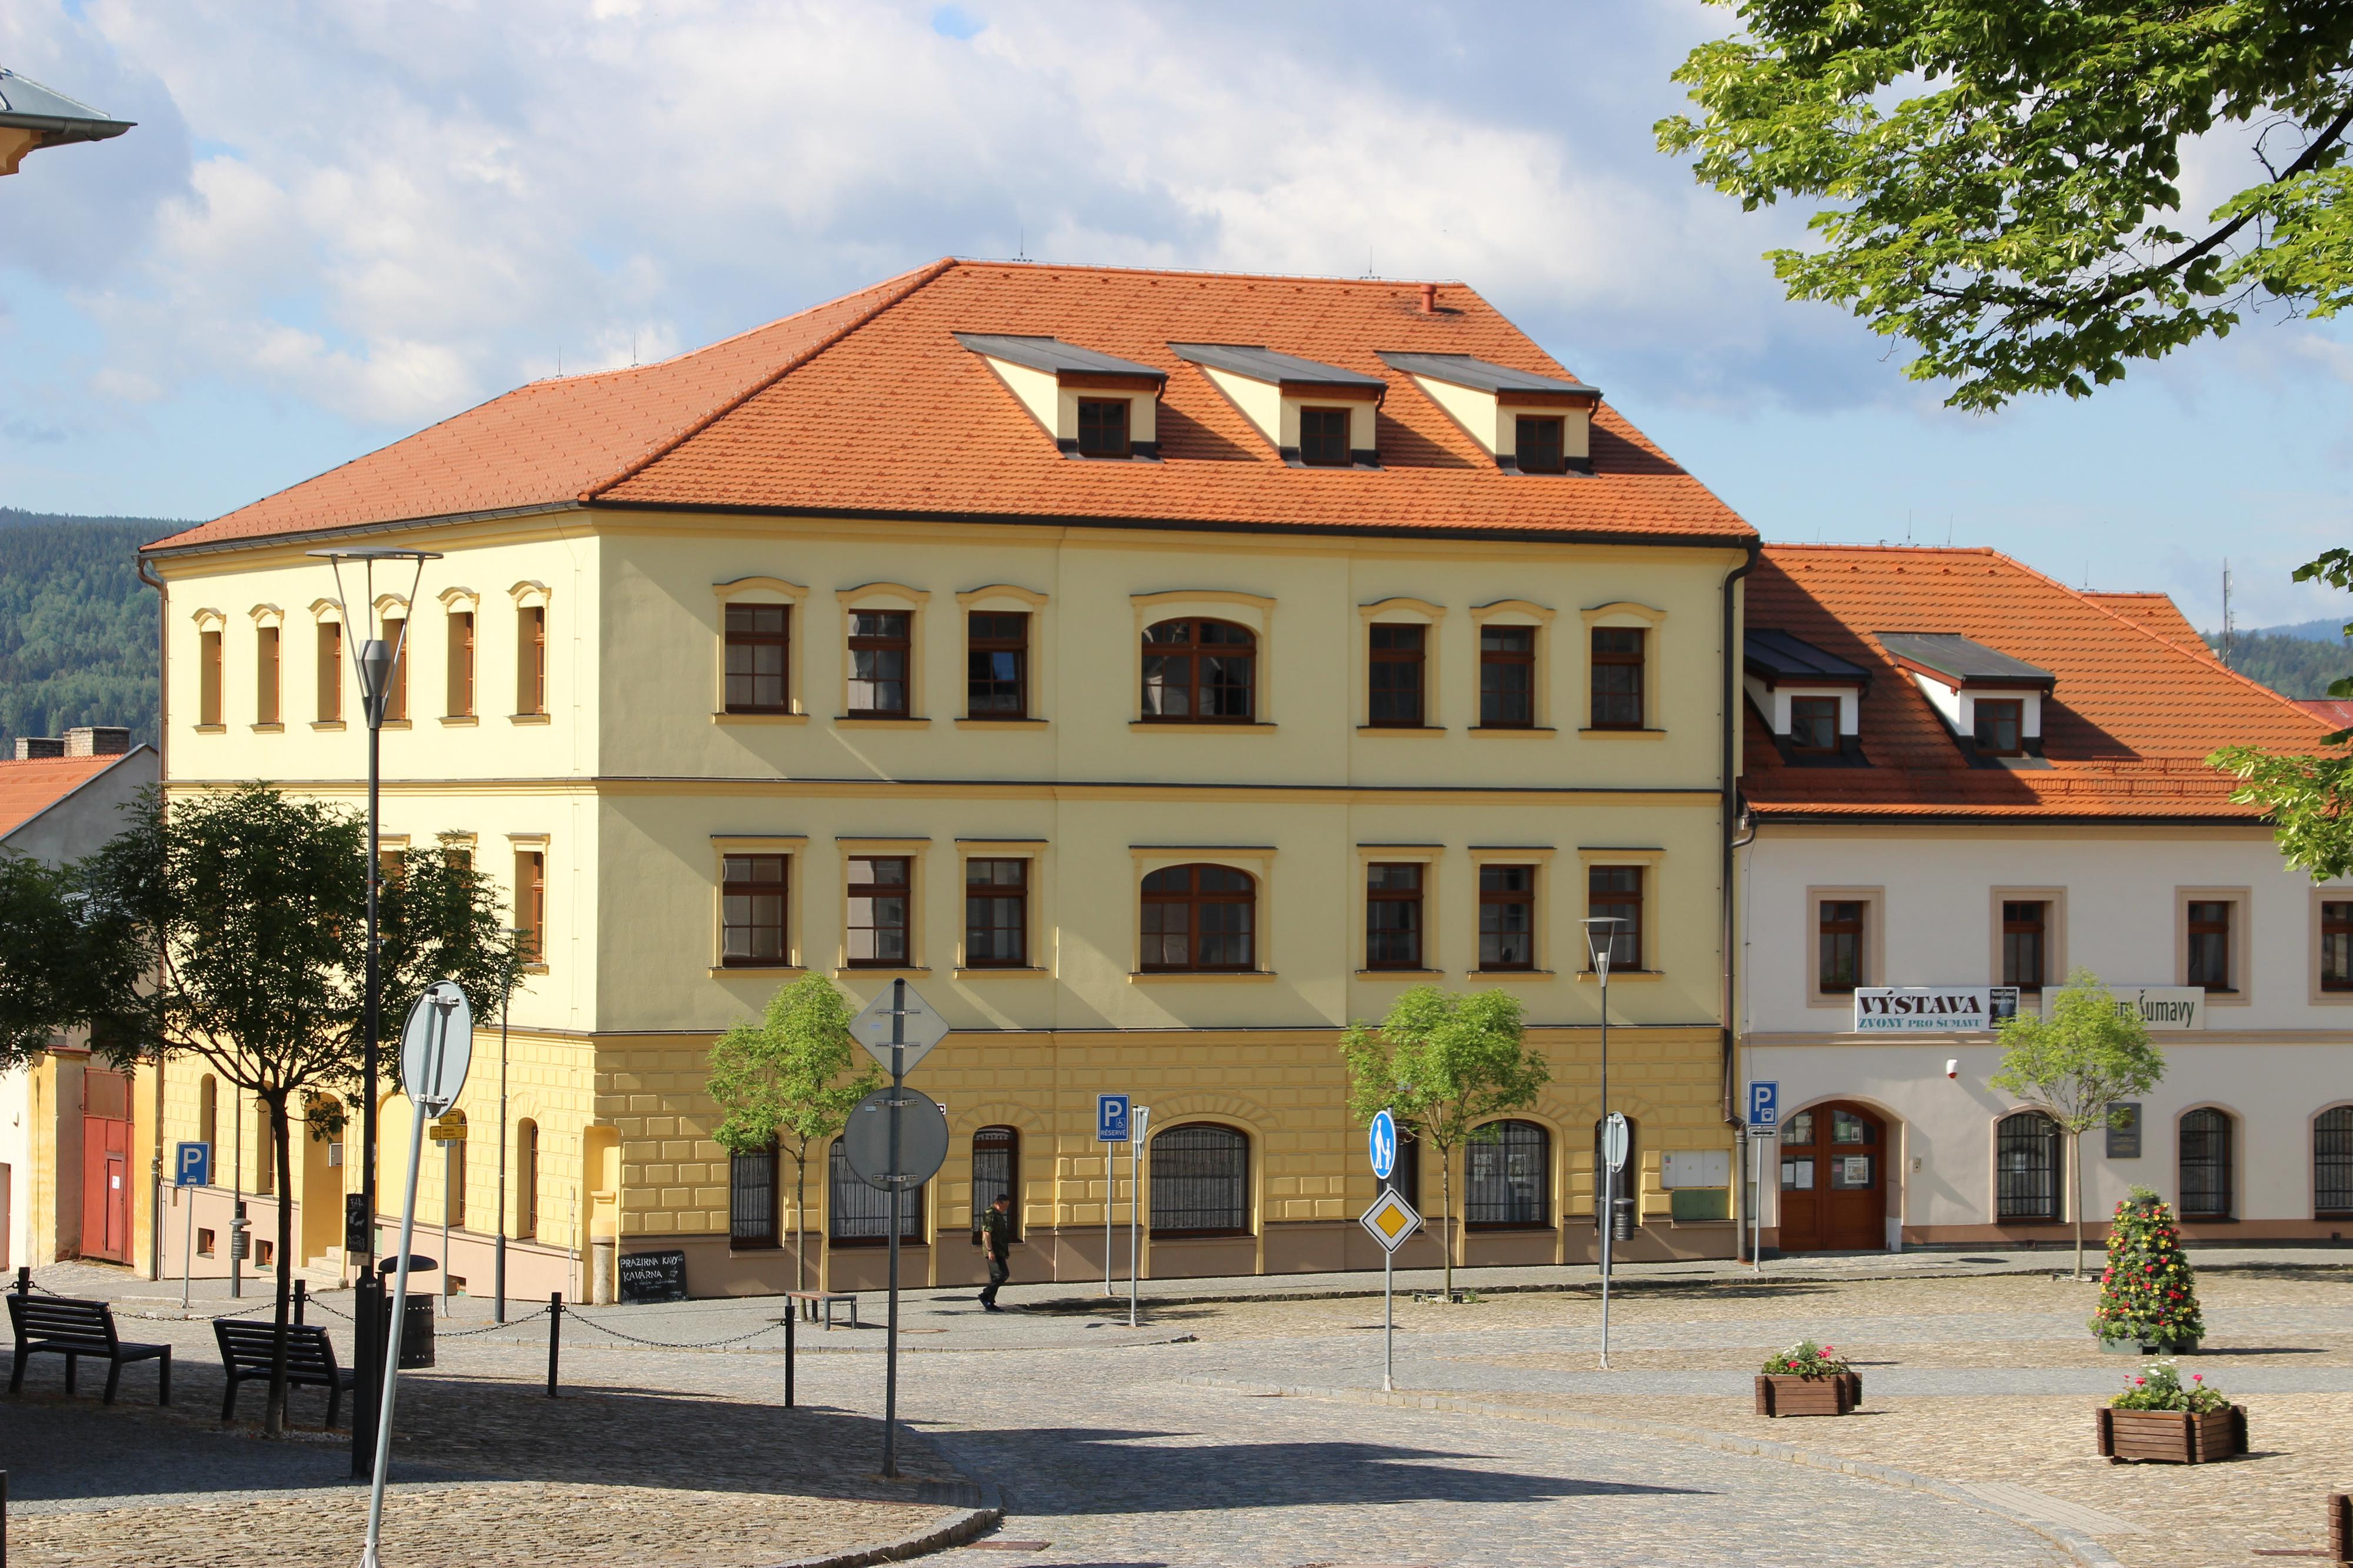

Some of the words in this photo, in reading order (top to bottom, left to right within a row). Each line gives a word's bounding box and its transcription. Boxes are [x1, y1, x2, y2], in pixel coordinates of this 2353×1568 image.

[1859, 990, 1982, 1015] VÝSTAVA
[2139, 989, 2195, 1027] Šumavy
[1859, 1018, 1904, 1028] ZVONY
[1937, 1017, 1982, 1027] ŠUMAVU
[1755, 1087, 1772, 1112] P
[1105, 1100, 1122, 1127] P
[183, 1147, 202, 1173] P
[624, 1269, 662, 1282] KAVÁRNA
